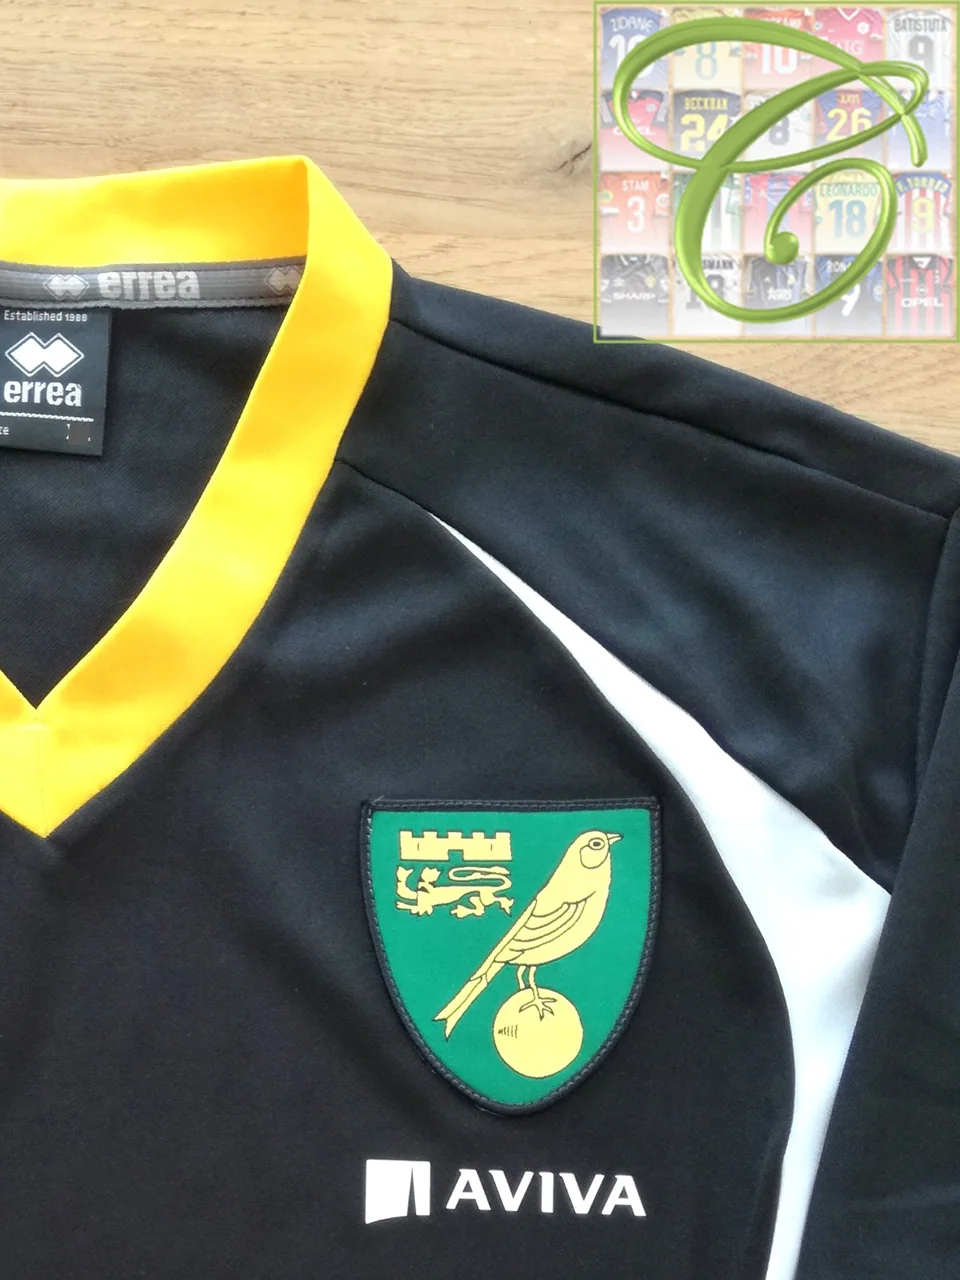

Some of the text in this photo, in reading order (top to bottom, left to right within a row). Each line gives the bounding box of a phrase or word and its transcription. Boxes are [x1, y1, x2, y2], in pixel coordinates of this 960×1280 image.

[3, 310, 88, 322] Established 1988
[446, 1168, 646, 1217] AVIVA
